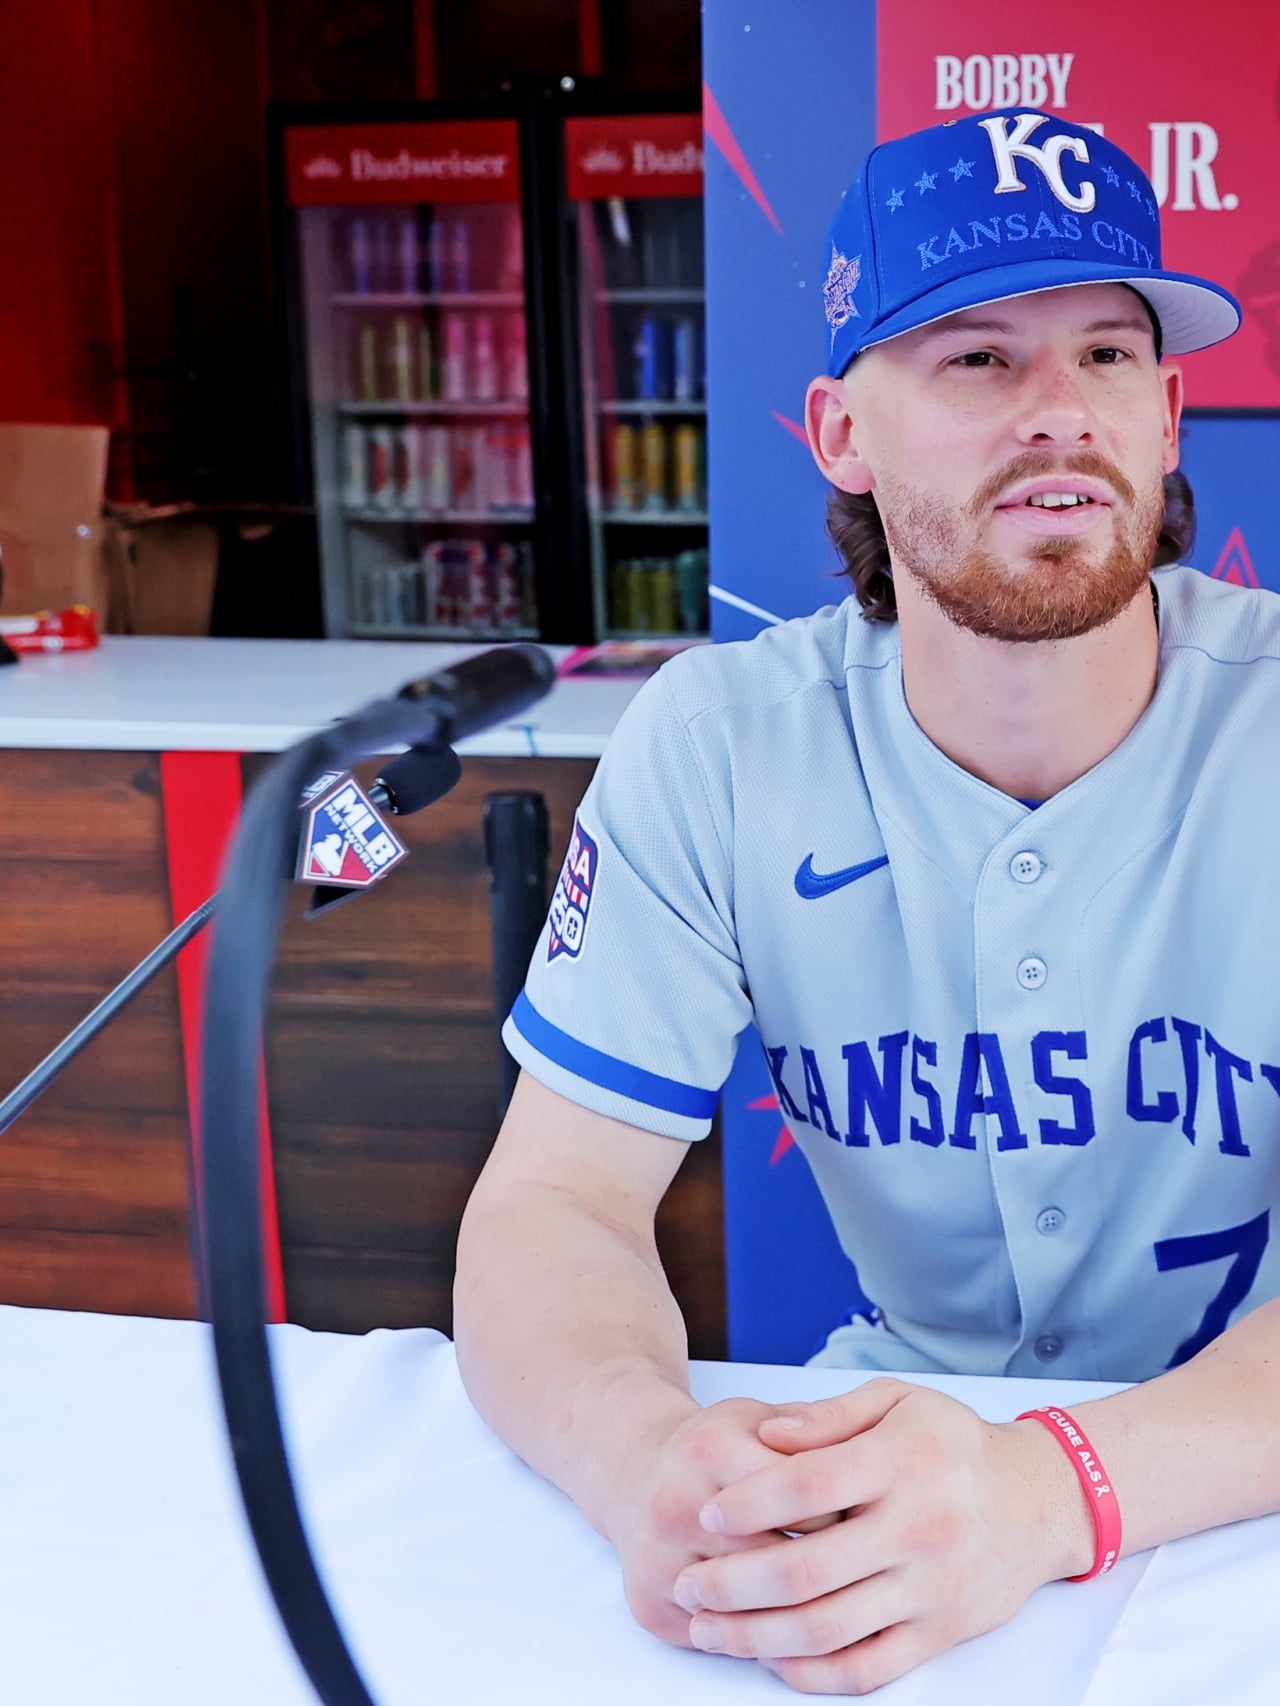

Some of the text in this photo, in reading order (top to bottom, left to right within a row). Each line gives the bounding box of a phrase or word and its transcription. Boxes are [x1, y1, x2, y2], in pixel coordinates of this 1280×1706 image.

[935, 53, 1075, 110] BOBBY
[350, 148, 510, 182] Budweiser
[978, 113, 1096, 213] KC
[1148, 121, 1239, 211] JR.
[916, 211, 1155, 271] KANSAS CITY
[323, 803, 379, 875] NETWORK
[331, 786, 397, 866] MLB
[766, 1030, 1095, 1152] KANSAS
[1153, 1207, 1271, 1370] 7
[1048, 1411, 1102, 1483] CURE ALS
